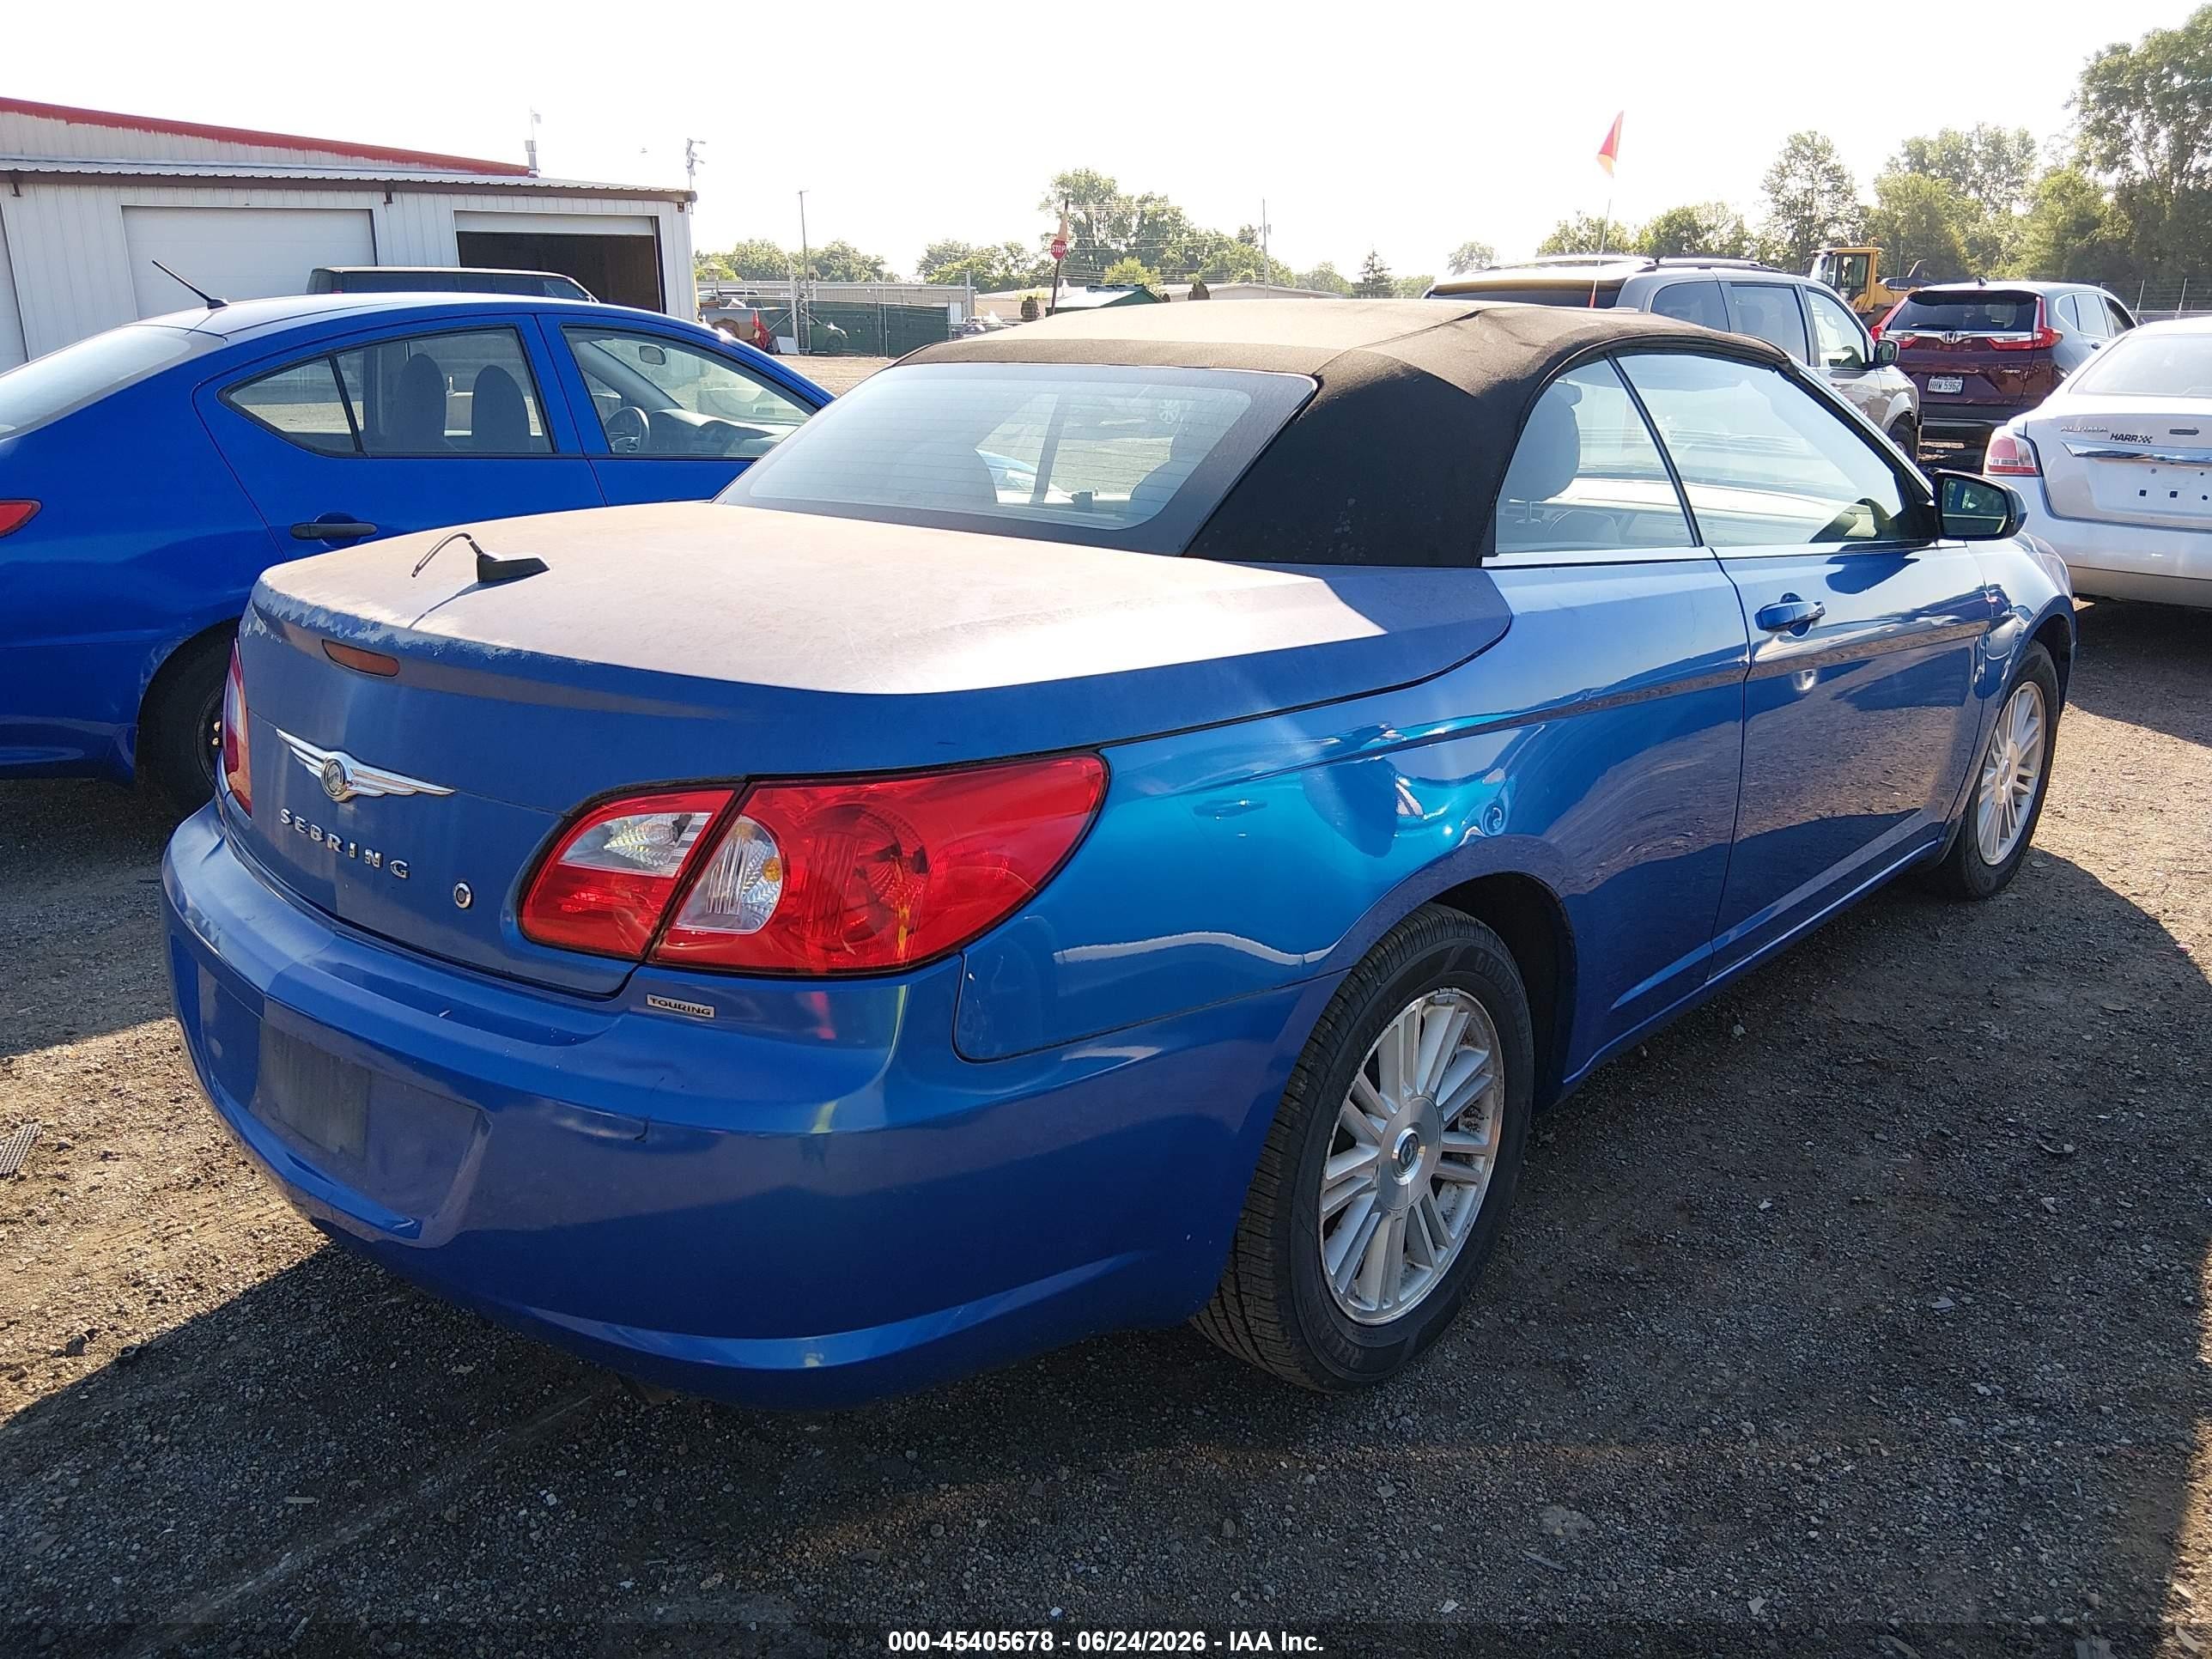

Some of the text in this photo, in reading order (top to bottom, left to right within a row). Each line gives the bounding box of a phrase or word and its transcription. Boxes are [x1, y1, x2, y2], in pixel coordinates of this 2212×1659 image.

[1052, 245, 1066, 253] STOP
[1944, 381, 1961, 391] 5962
[280, 808, 410, 878] SEBRING
[650, 998, 711, 1015] TOURING
